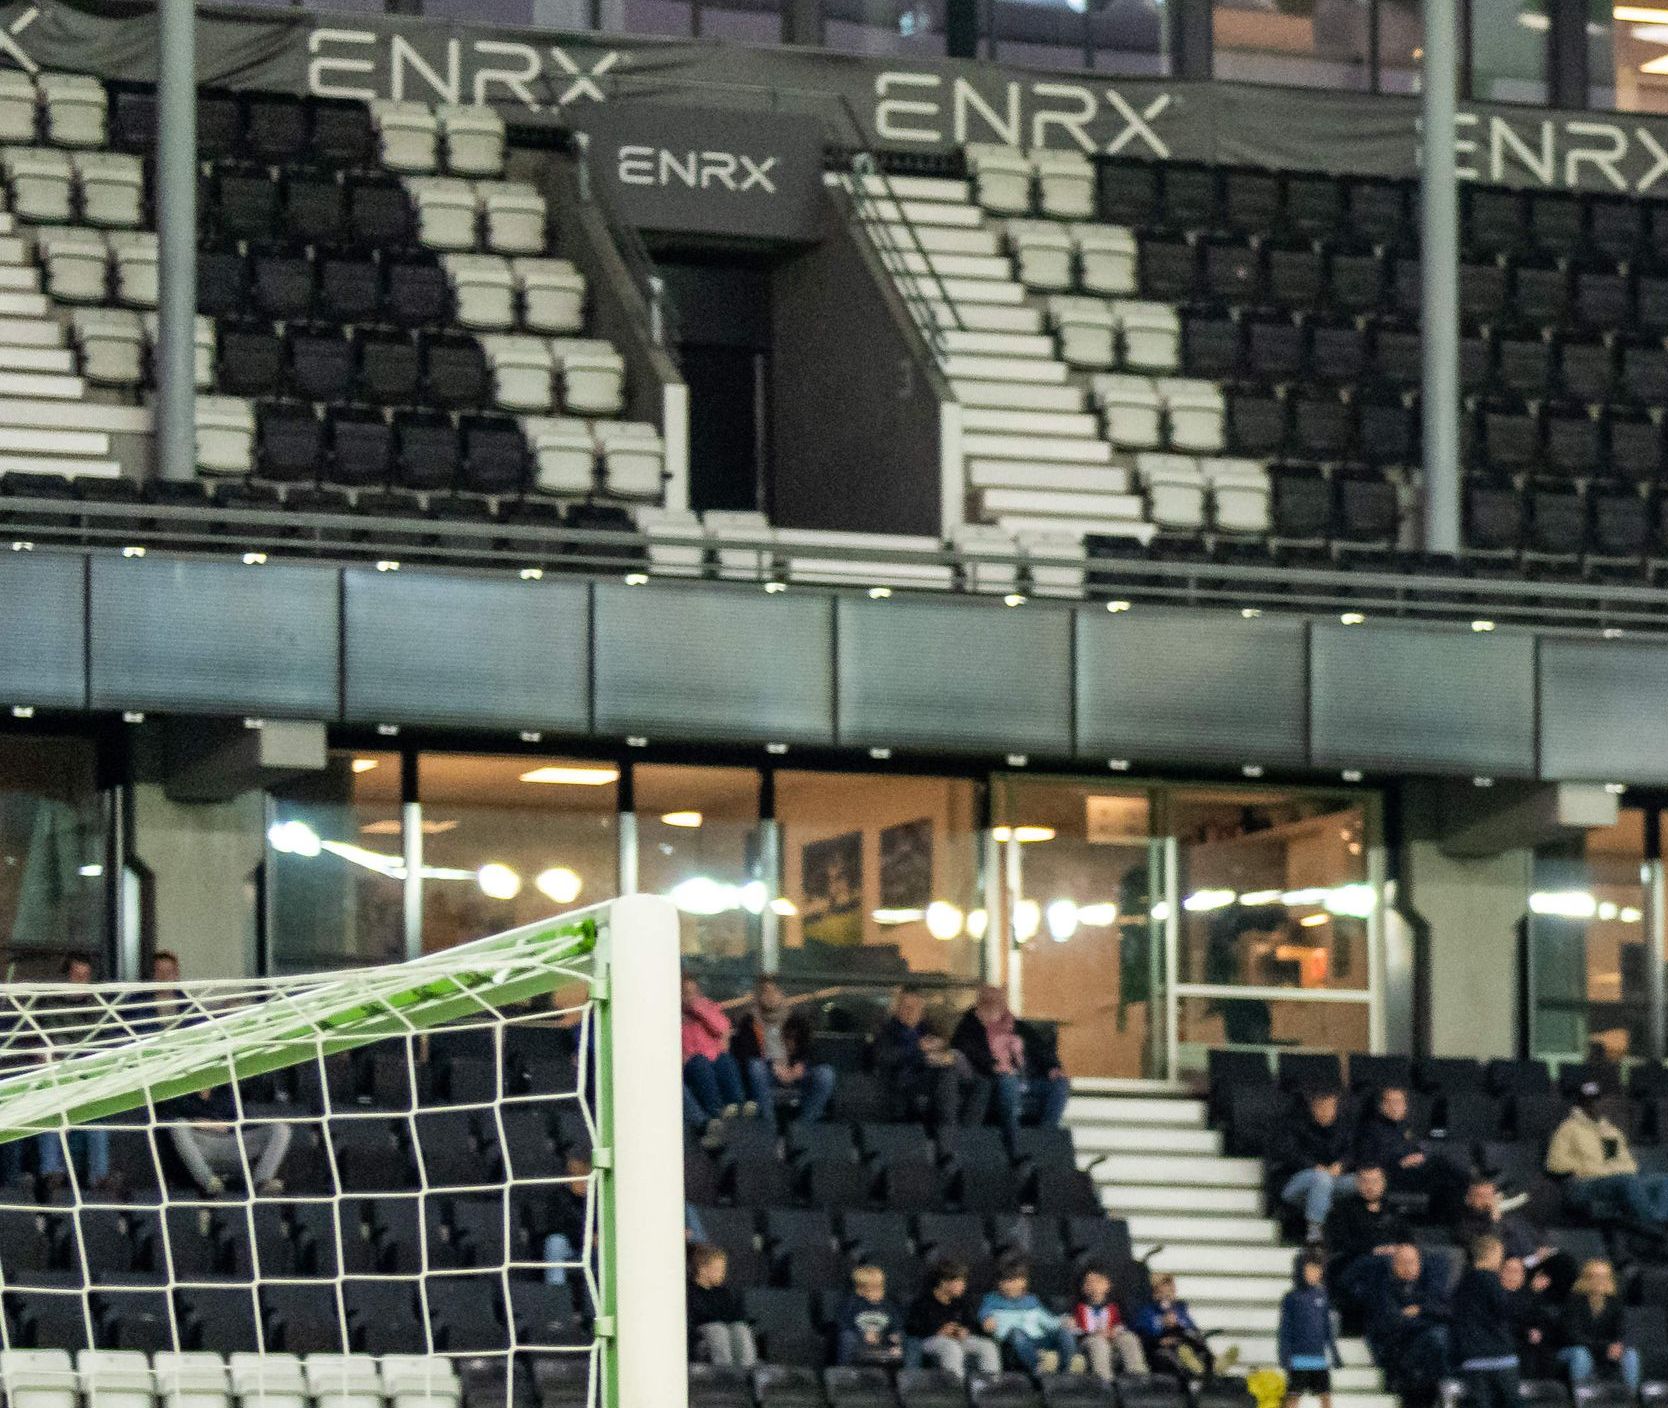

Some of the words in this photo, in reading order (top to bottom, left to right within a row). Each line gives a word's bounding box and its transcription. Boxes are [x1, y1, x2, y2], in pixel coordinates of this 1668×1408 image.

[308, 28, 618, 111] ENRX
[875, 72, 1170, 159] ENRX
[618, 146, 776, 193] ENRX
